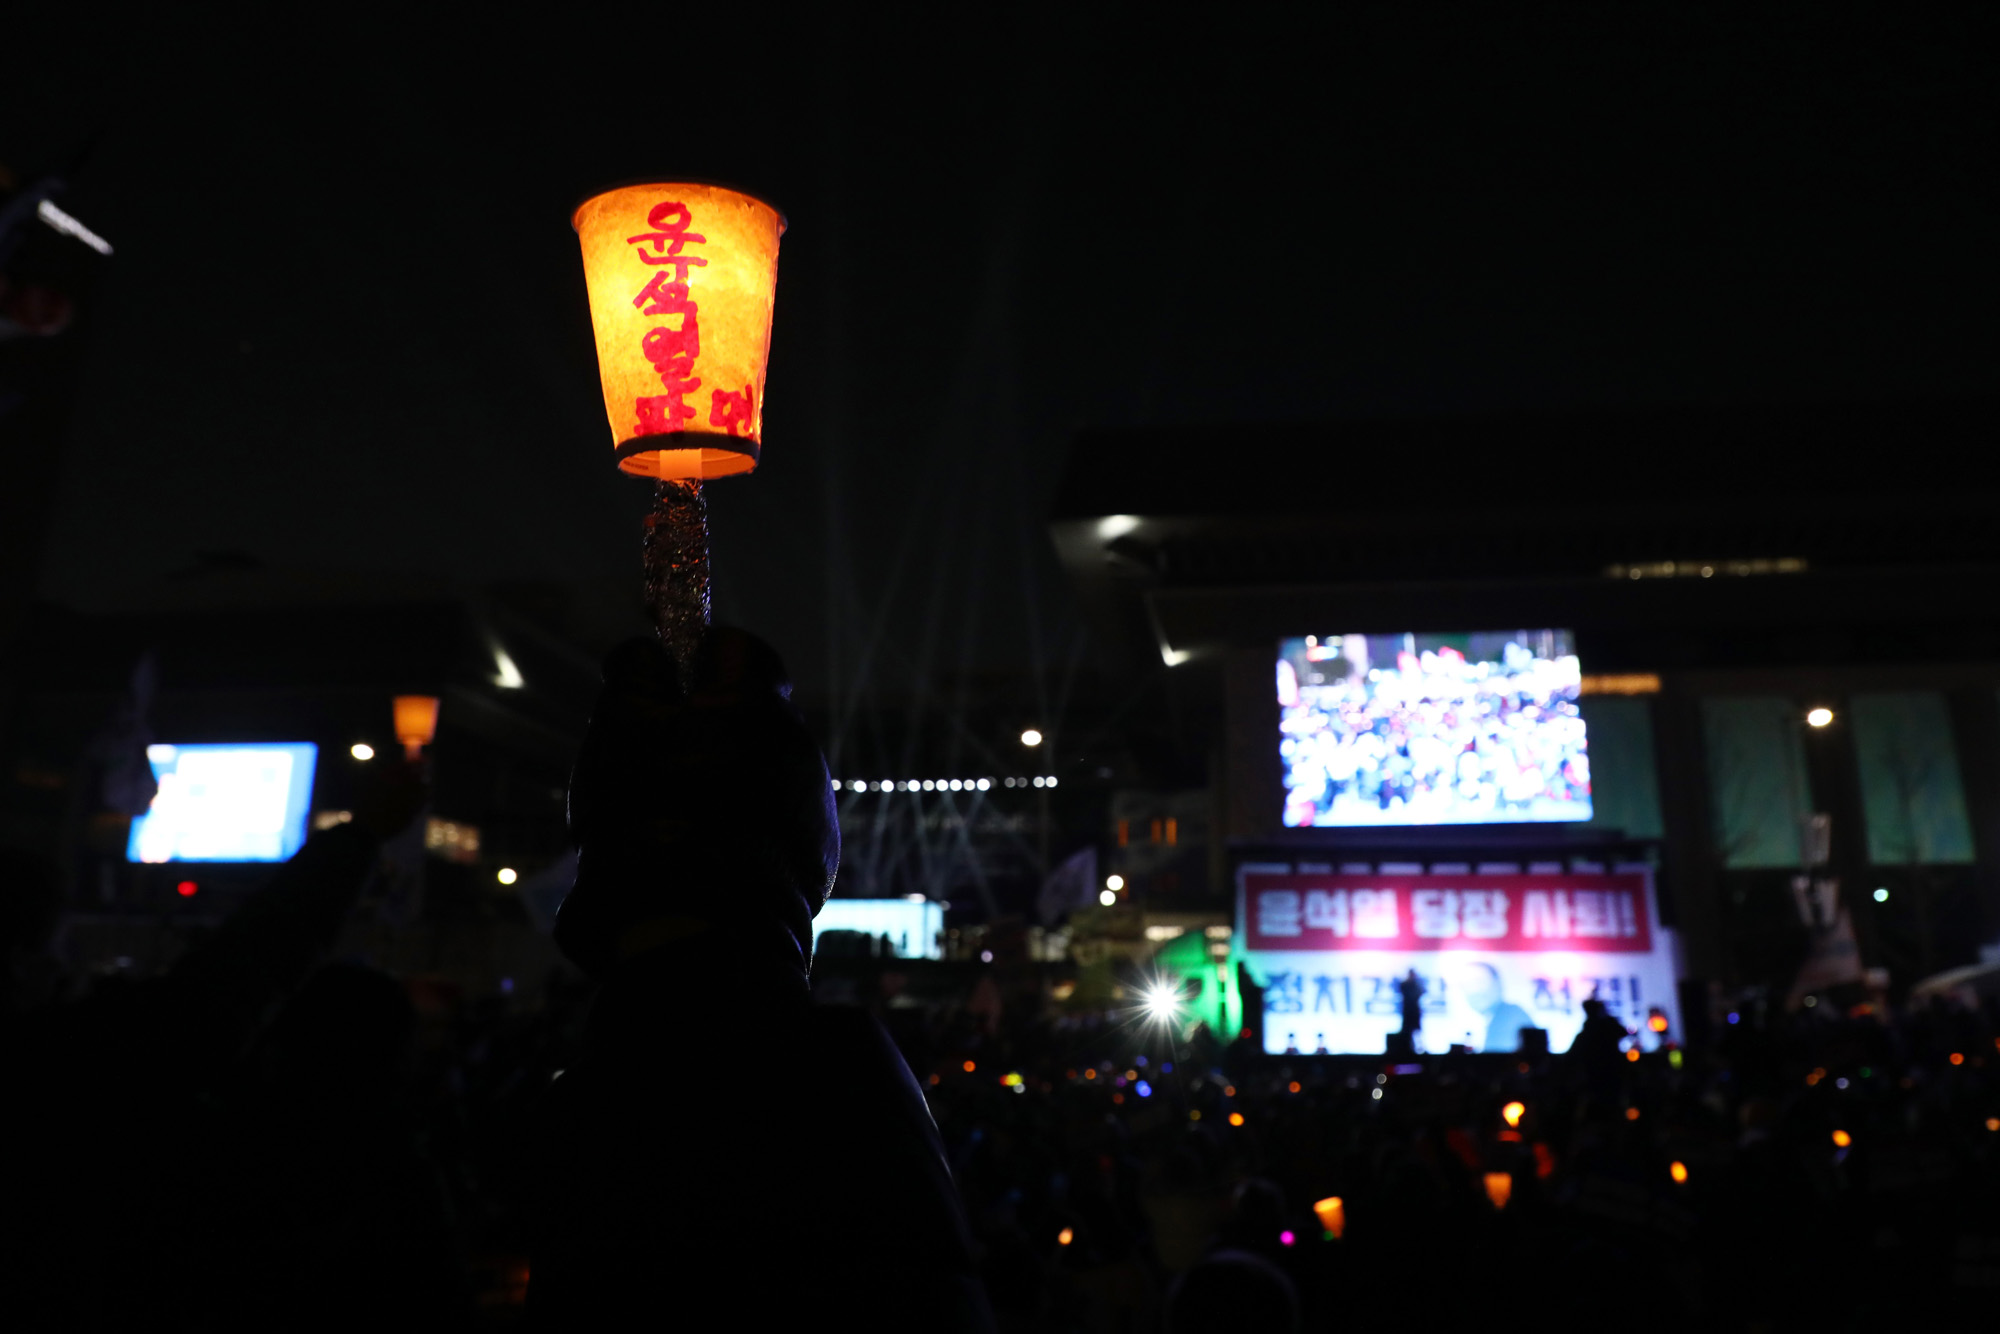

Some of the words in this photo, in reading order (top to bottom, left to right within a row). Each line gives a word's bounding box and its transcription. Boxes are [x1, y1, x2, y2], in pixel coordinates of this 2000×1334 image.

[627, 201, 707, 394] 윤석열
[1258, 889, 1398, 938] 윤석열
[1412, 888, 1508, 938] 당장
[1523, 888, 1636, 938] 사퇴!
